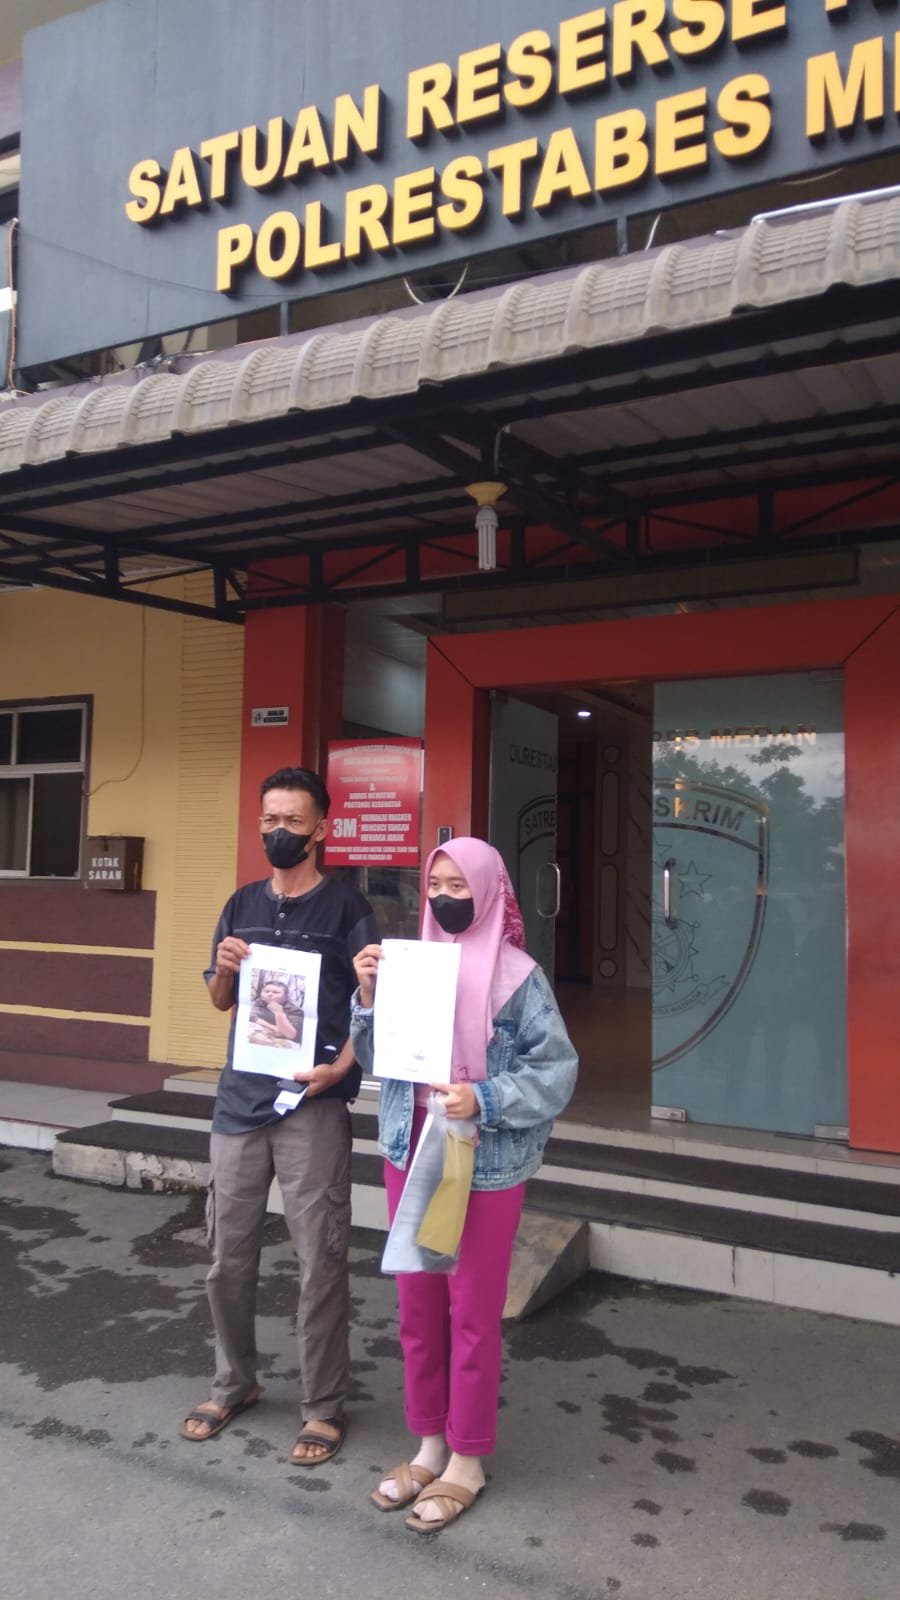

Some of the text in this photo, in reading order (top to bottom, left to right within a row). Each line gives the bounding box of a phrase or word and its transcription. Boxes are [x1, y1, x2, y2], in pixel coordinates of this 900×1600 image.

[125, 83, 379, 223] SATUAN
[216, 31, 900, 292] POLRESTABES M
[709, 724, 817, 750] MEDAN
[332, 818, 357, 838] 3M
[654, 796, 745, 831] SKRIM
[91, 857, 120, 868] KOTAK
